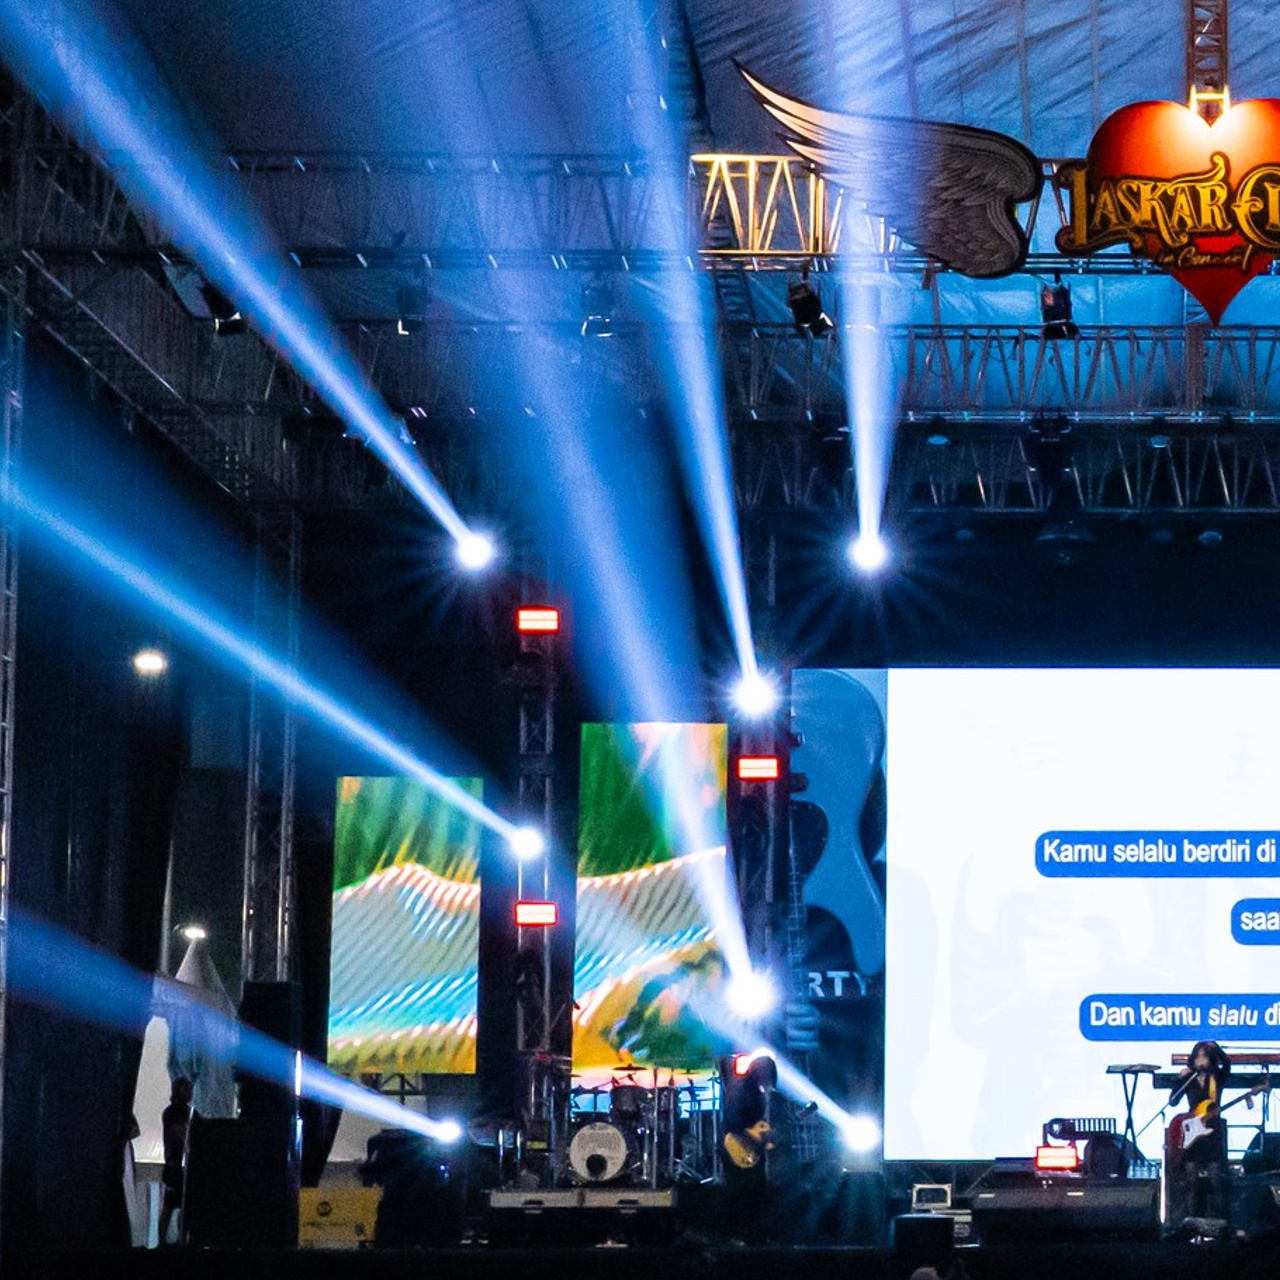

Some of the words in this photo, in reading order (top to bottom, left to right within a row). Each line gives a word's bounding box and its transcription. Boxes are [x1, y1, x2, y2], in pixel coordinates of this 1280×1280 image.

[1066, 152, 1233, 248] LASKAR
[1043, 838, 1107, 863] Kamu
[1113, 838, 1177, 863] selalu
[1183, 838, 1251, 863] berdiri
[1256, 838, 1276, 863] di
[1090, 1001, 1135, 1027] Dan
[1139, 1000, 1201, 1027] kamu
[1207, 1003, 1259, 1026] slalu
